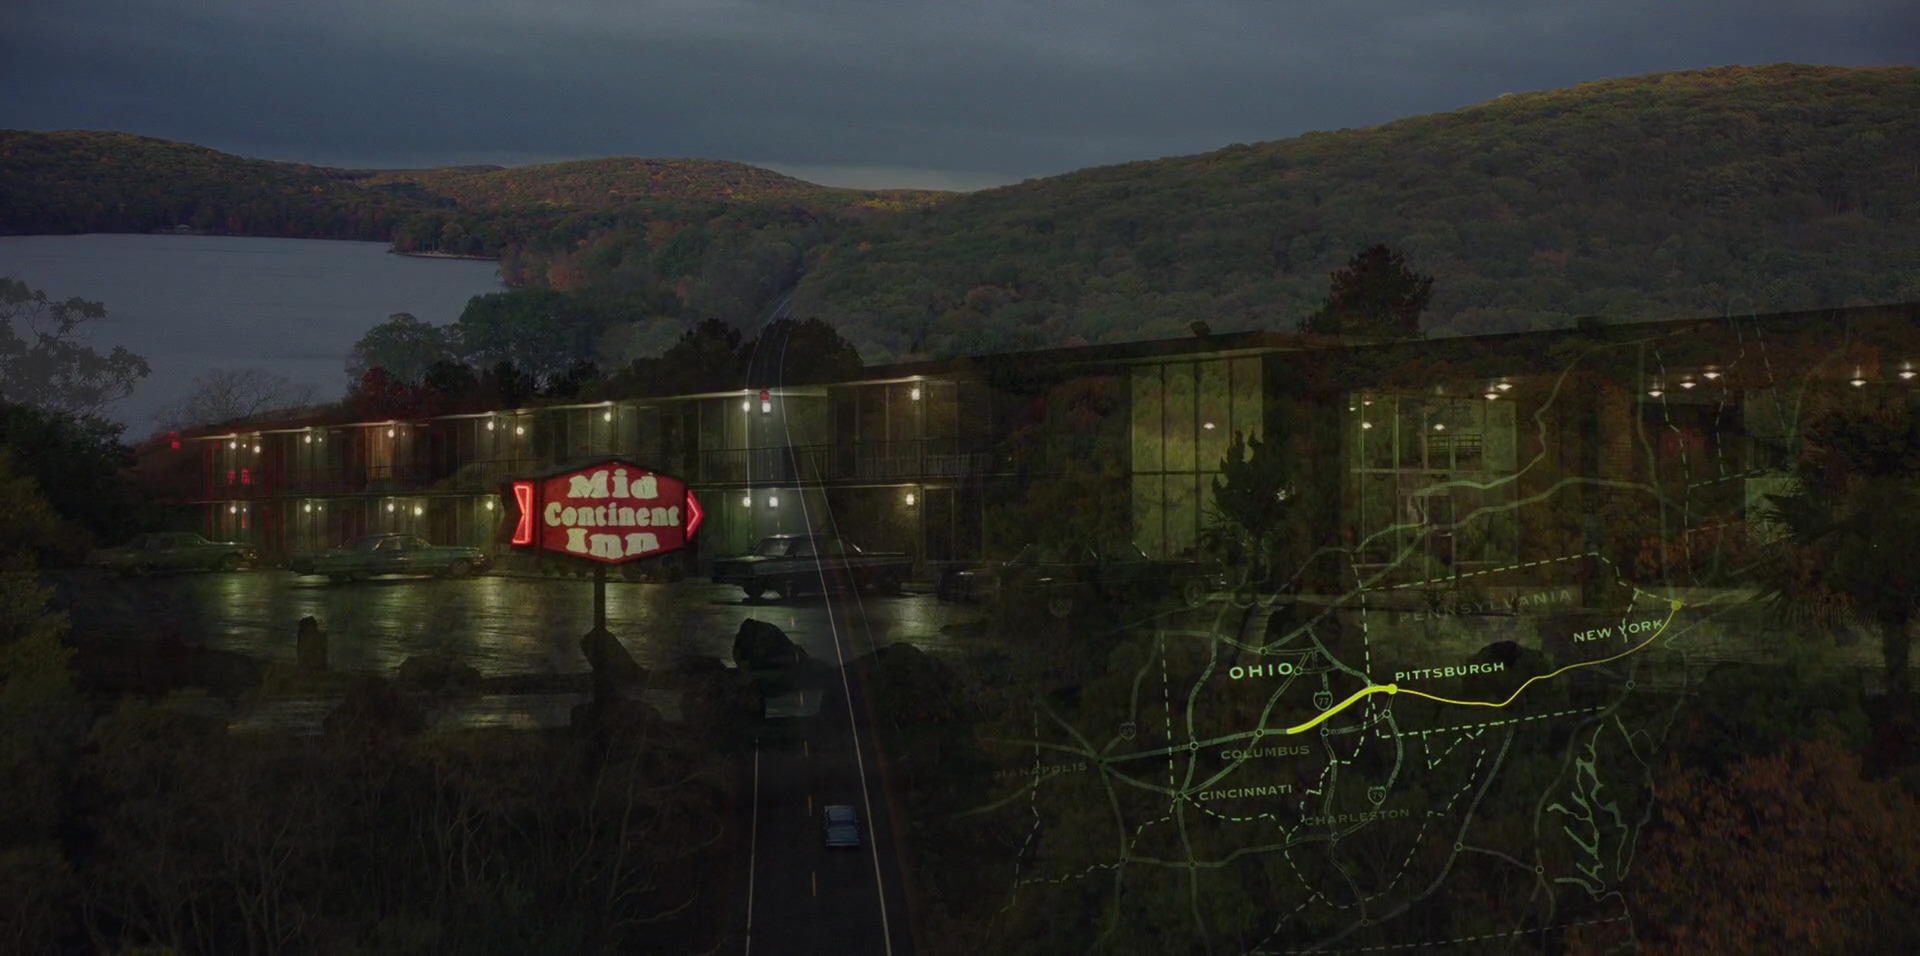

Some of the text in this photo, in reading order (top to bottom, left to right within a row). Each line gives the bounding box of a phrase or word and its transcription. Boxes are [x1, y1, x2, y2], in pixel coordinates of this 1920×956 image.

[567, 468, 658, 499] Mid
[544, 501, 680, 527] Continent
[565, 528, 660, 560] Inn
